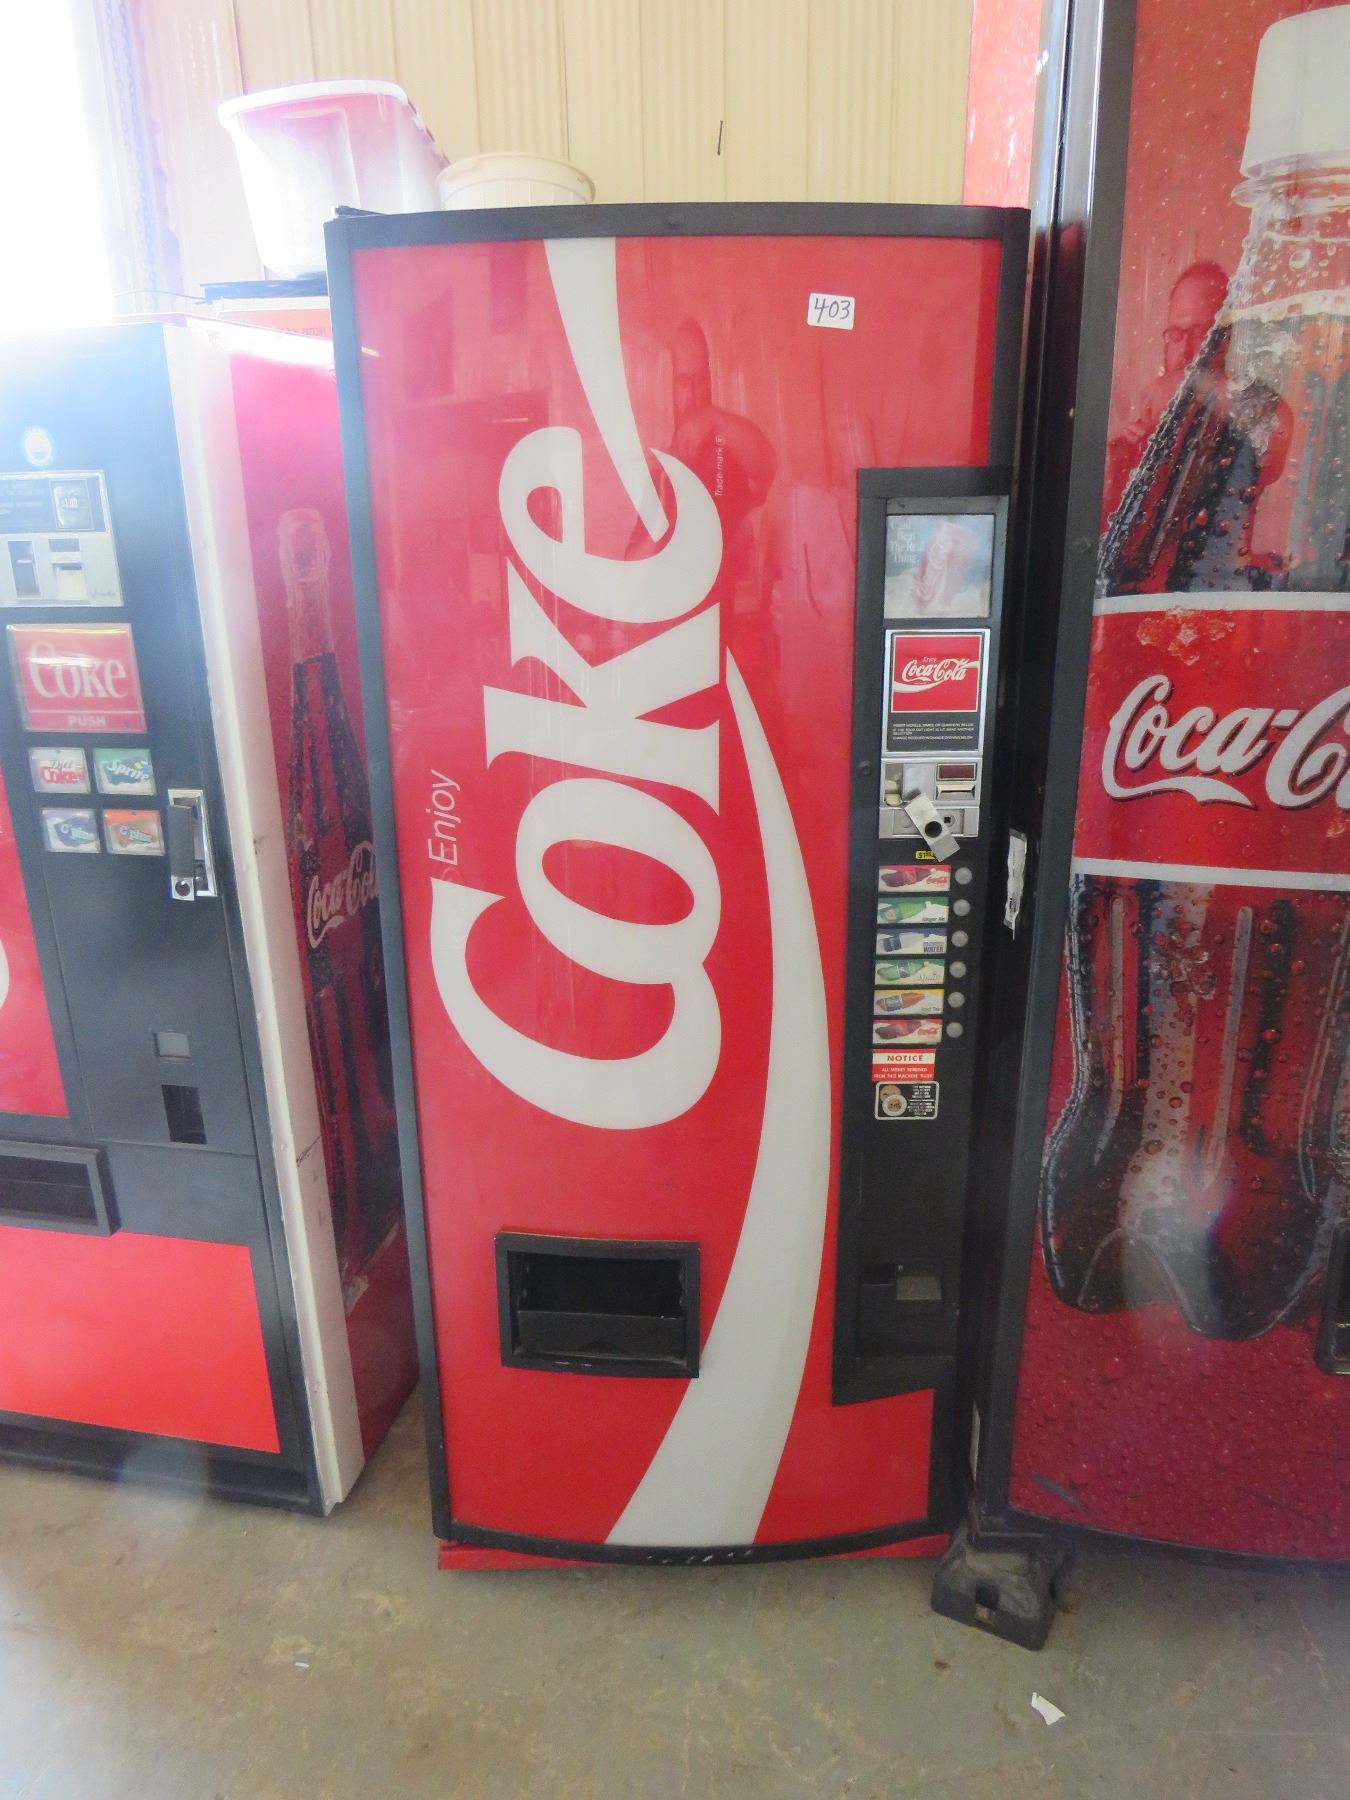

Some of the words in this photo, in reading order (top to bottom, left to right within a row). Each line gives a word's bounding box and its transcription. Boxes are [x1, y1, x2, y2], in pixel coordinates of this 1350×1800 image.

[814, 297, 851, 324] 403
[27, 640, 128, 699] Coke
[901, 658, 969, 683] Coca-Cola
[68, 714, 107, 727] PUSH
[106, 759, 150, 781] Sprite
[430, 425, 723, 1131] Coke
[425, 769, 461, 865] Enjoy
[887, 1054, 924, 1062] NOTICE
